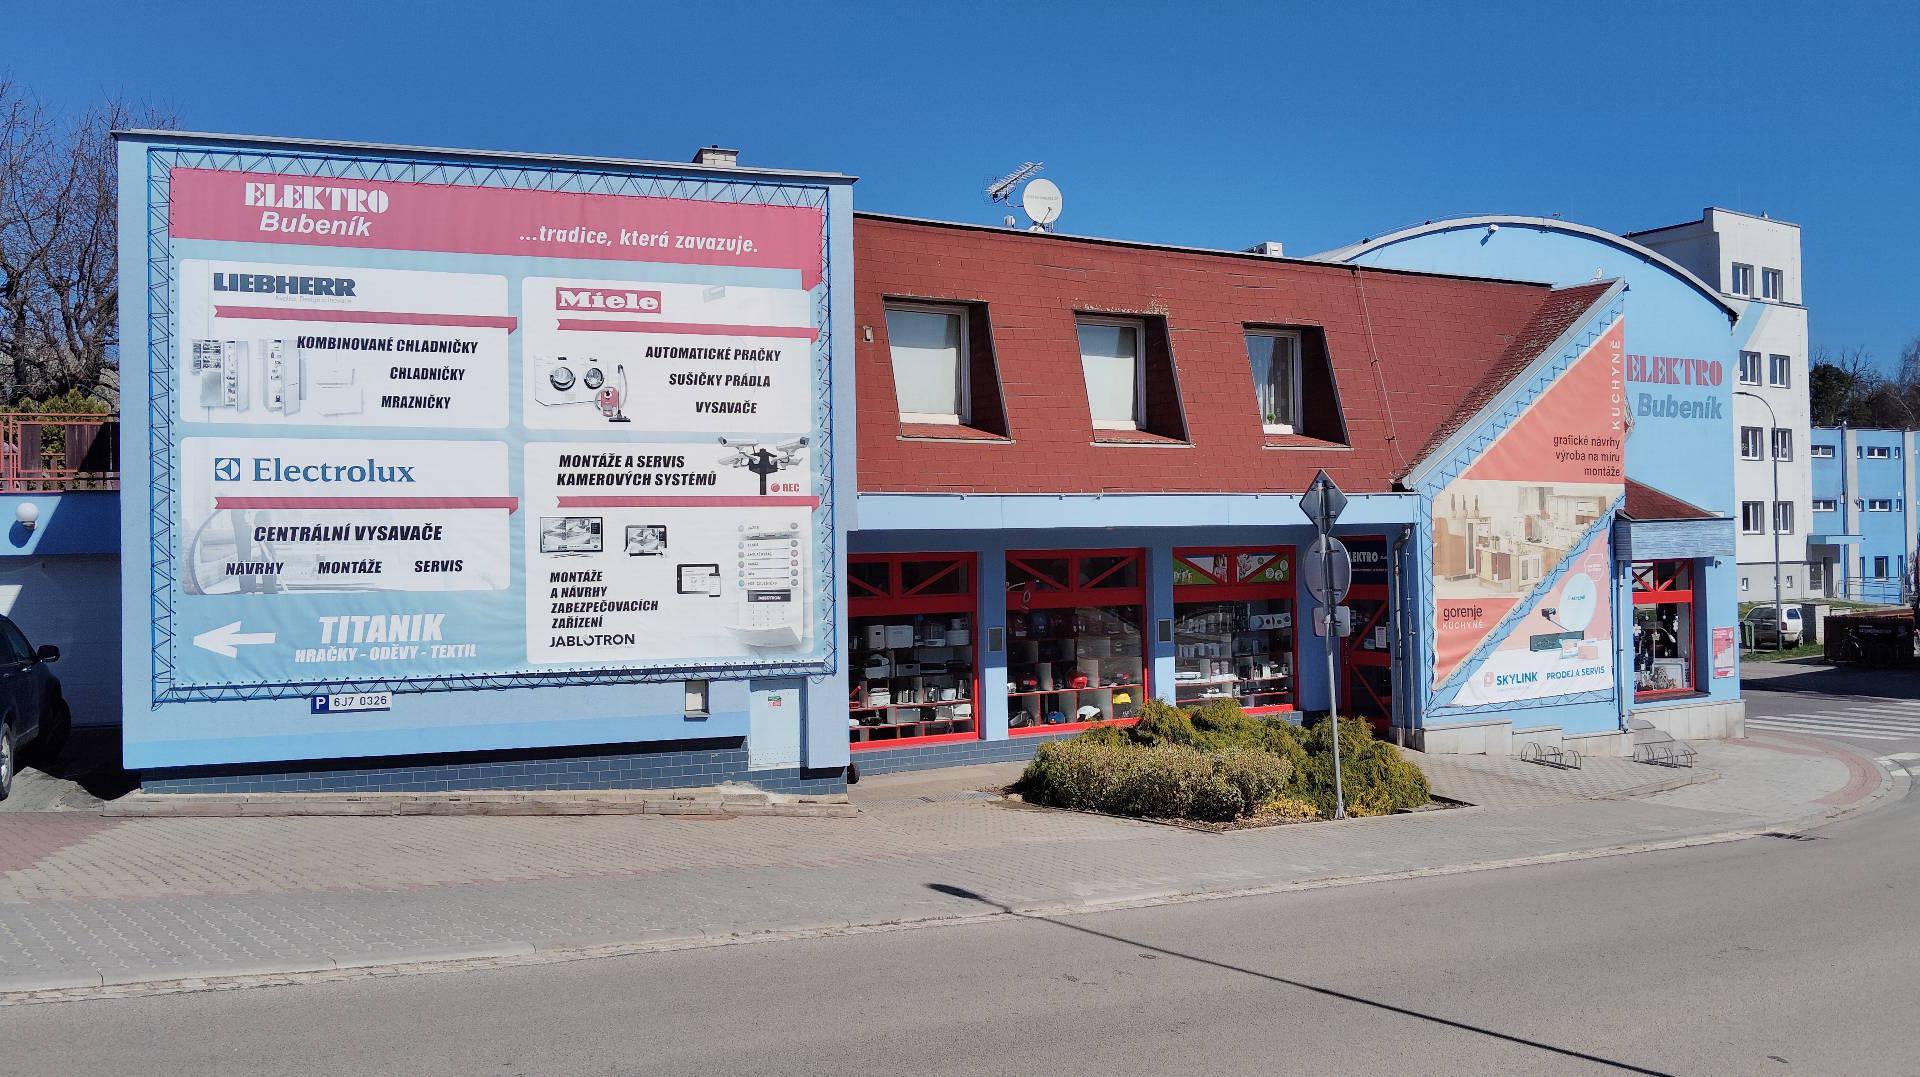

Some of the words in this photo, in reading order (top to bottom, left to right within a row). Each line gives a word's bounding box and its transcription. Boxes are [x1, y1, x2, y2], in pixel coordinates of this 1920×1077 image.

[244, 182, 389, 214] ELEKTRO
[259, 211, 373, 237] Bubeník
[519, 224, 612, 247] ...tradice,
[620, 229, 669, 248] která
[675, 235, 758, 255] zavazuje.
[213, 272, 356, 297] LIEBHERR
[558, 290, 659, 311] Miele
[296, 334, 394, 352] KOMBINOVANÉ
[396, 337, 479, 354] CHLADNIČKY
[645, 345, 732, 361] AUTOMATICKÉ
[733, 347, 781, 363] PRAČKY
[390, 365, 465, 381] CHLADNIČKY
[1626, 354, 1723, 387] ELEKTRO
[668, 372, 722, 387] SUŠIČKY
[724, 372, 771, 388] PRÁDLA
[1610, 339, 1621, 430] KUCHYNĚ
[381, 394, 451, 410] MRAZNIČKY
[695, 400, 757, 415] VYSAVAČE
[1637, 392, 1723, 420] Bubeník
[1553, 434, 1589, 447] grafické
[1591, 436, 1621, 449] návrhy
[558, 453, 622, 468] MONTÁŽE
[624, 455, 634, 468] A
[636, 455, 685, 468] SERVIS
[1555, 449, 1586, 463] výroba
[1588, 452, 1599, 462] na
[252, 458, 416, 483] Electrolux
[556, 470, 652, 487] KAMEROVÝCH
[653, 470, 717, 486] SYSTÉMŮ
[1584, 466, 1621, 477] montáže
[782, 483, 800, 493] REC
[254, 523, 351, 542] CENTRÁLNÍ
[355, 523, 442, 541] VYSAVAČE
[1349, 551, 1378, 563] LEKTRO
[225, 560, 284, 576] NÁVRHY
[318, 558, 382, 574] MONTÁŽE
[414, 559, 463, 573] SERVIS
[550, 570, 603, 583] MONTÁŽE
[550, 587, 559, 599] A
[560, 584, 608, 598] NÁVRHY
[550, 598, 659, 614] ZABEZPEČOVACÍCH
[1443, 604, 1483, 621] gorenje
[319, 613, 446, 644] TITANIK
[551, 615, 604, 629] ZAŘÍZENÍ
[549, 633, 636, 648] JABLOTRON
[294, 645, 359, 663] HRAČKY
[369, 644, 418, 661] ODĚVY
[430, 644, 477, 659] TEXTIL
[1496, 671, 1538, 686] SKYLINK
[1546, 669, 1575, 681] PRODEJ
[1576, 667, 1581, 678] A
[1581, 665, 1605, 677] SERVIS
[316, 696, 326, 710] P
[334, 697, 354, 707] 6J7
[360, 695, 387, 706] 0326
